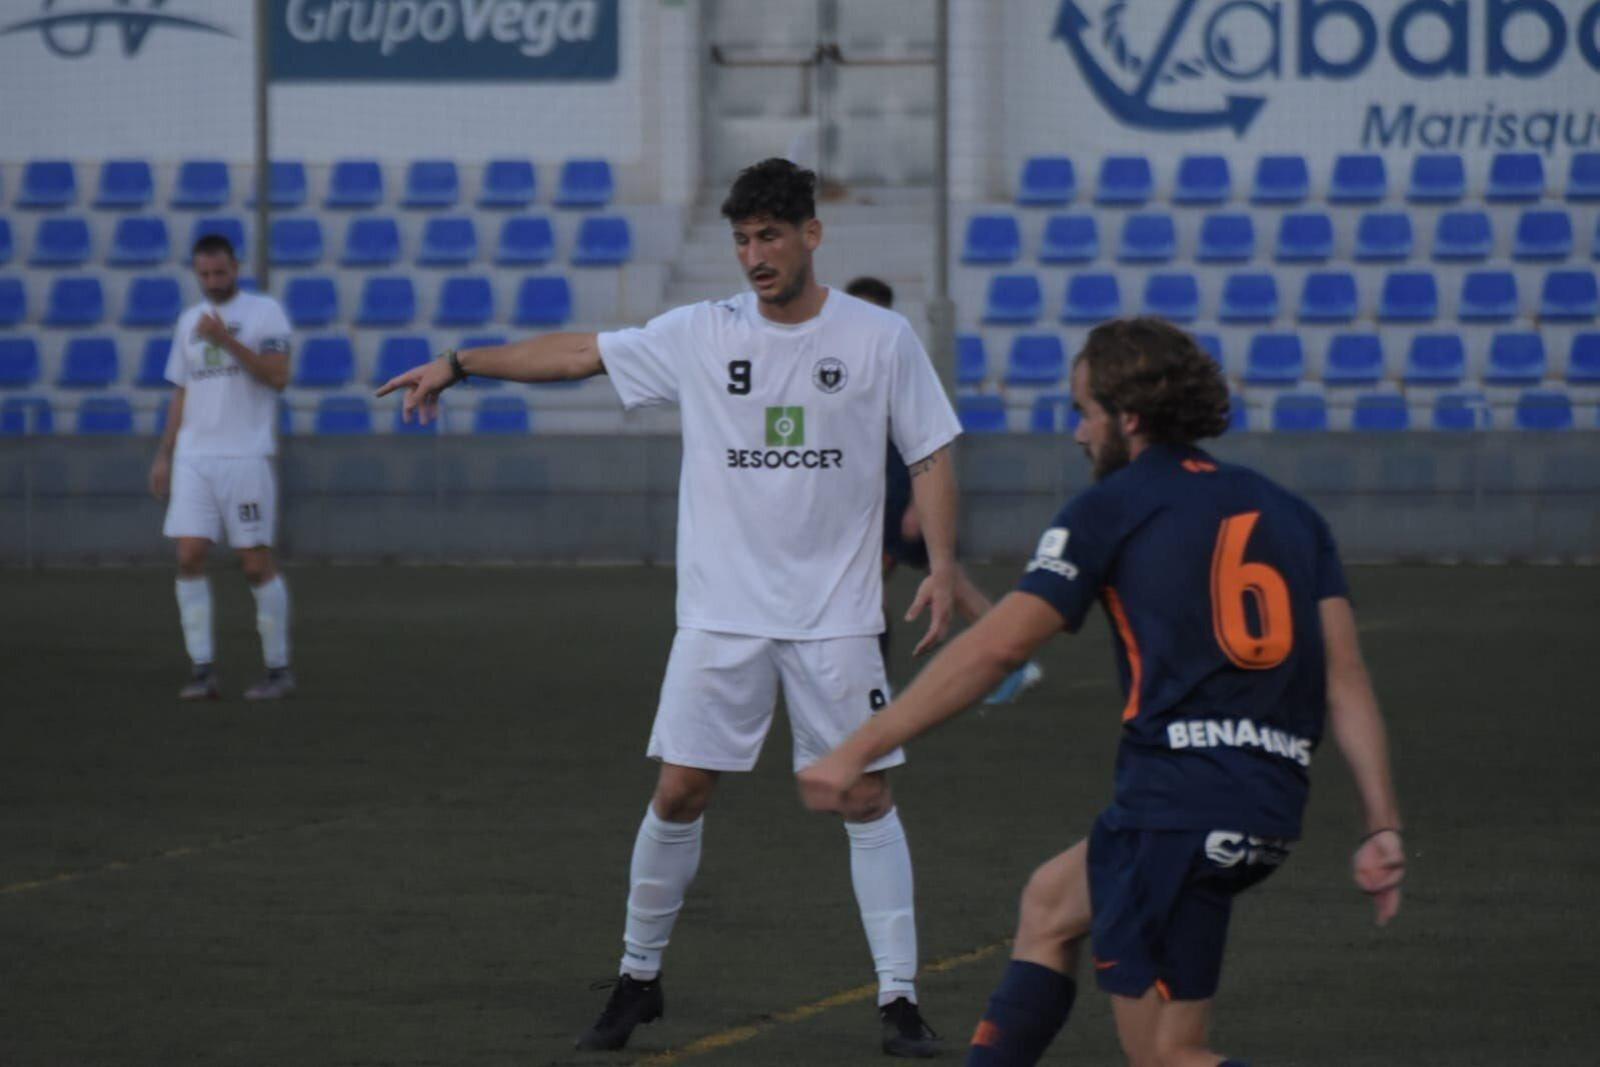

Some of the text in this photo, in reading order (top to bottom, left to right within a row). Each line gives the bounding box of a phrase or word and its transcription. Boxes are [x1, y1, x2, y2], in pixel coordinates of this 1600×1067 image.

[1361, 102, 1600, 157] Marisqu
[727, 359, 752, 395] 9
[727, 449, 843, 469] BESOCCER
[1210, 511, 1294, 670] 6
